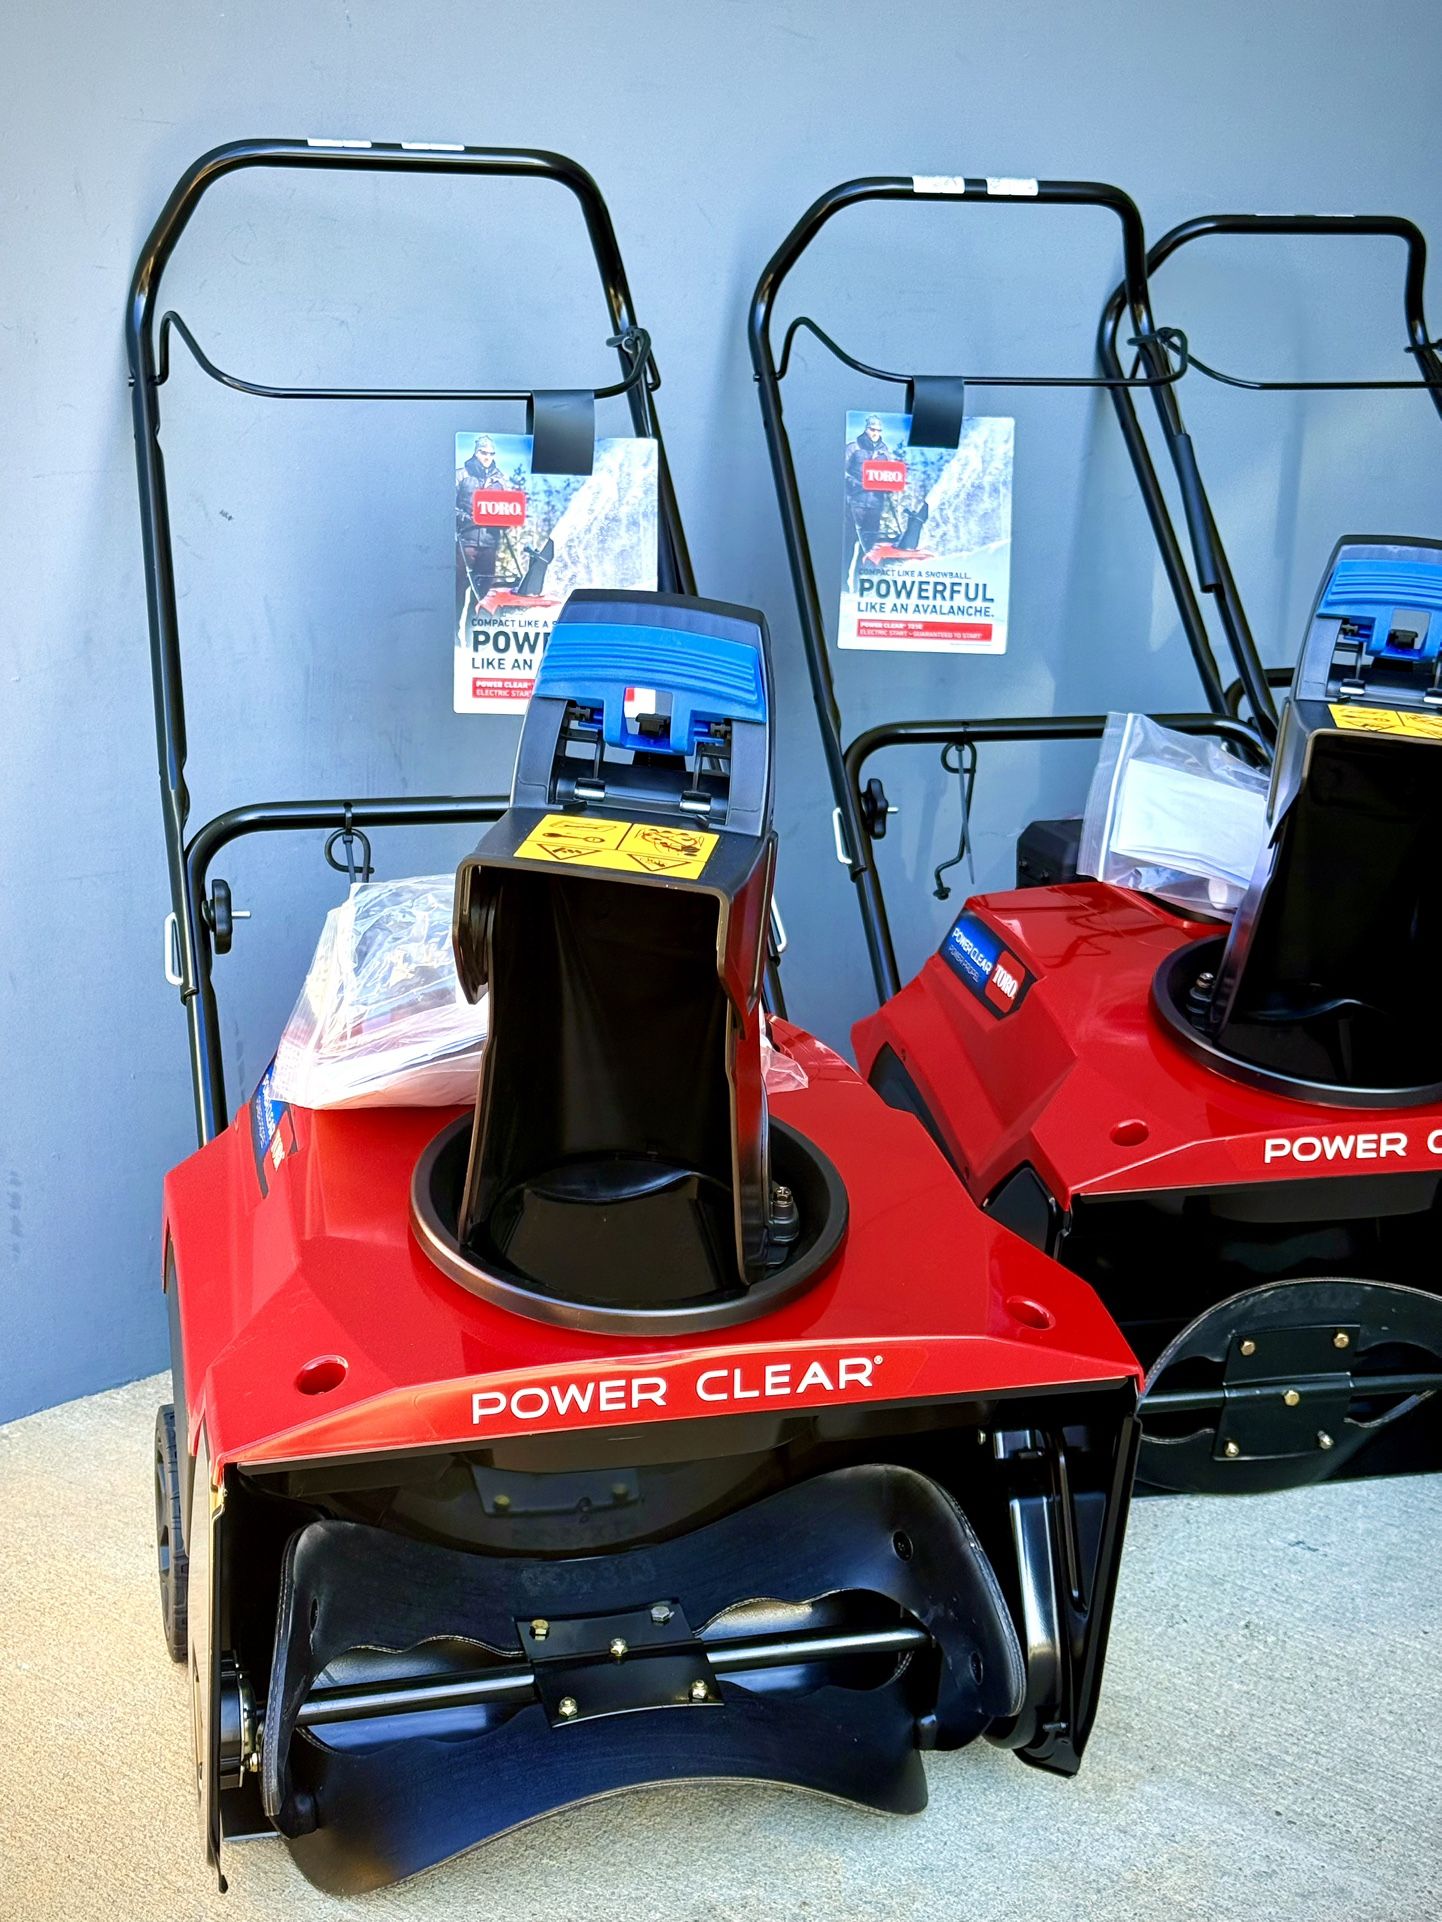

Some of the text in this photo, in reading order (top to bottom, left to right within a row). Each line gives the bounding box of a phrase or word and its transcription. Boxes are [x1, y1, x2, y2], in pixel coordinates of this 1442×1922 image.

[866, 470, 903, 482] TORO
[477, 501, 521, 516] TORO
[859, 568, 896, 577] COMPACT
[859, 578, 994, 603] POWERFUL
[857, 602, 995, 617] LIKE AN AVALANCHE.
[471, 618, 515, 627] COMPACT
[519, 620, 540, 628] LIKE
[542, 620, 549, 628] A
[471, 658, 533, 671] LIKE AN
[952, 928, 993, 975] POWER CLEAR
[992, 964, 1018, 1000] TORO
[1264, 1132, 1408, 1164] POWER
[472, 1376, 667, 1424] POWER
